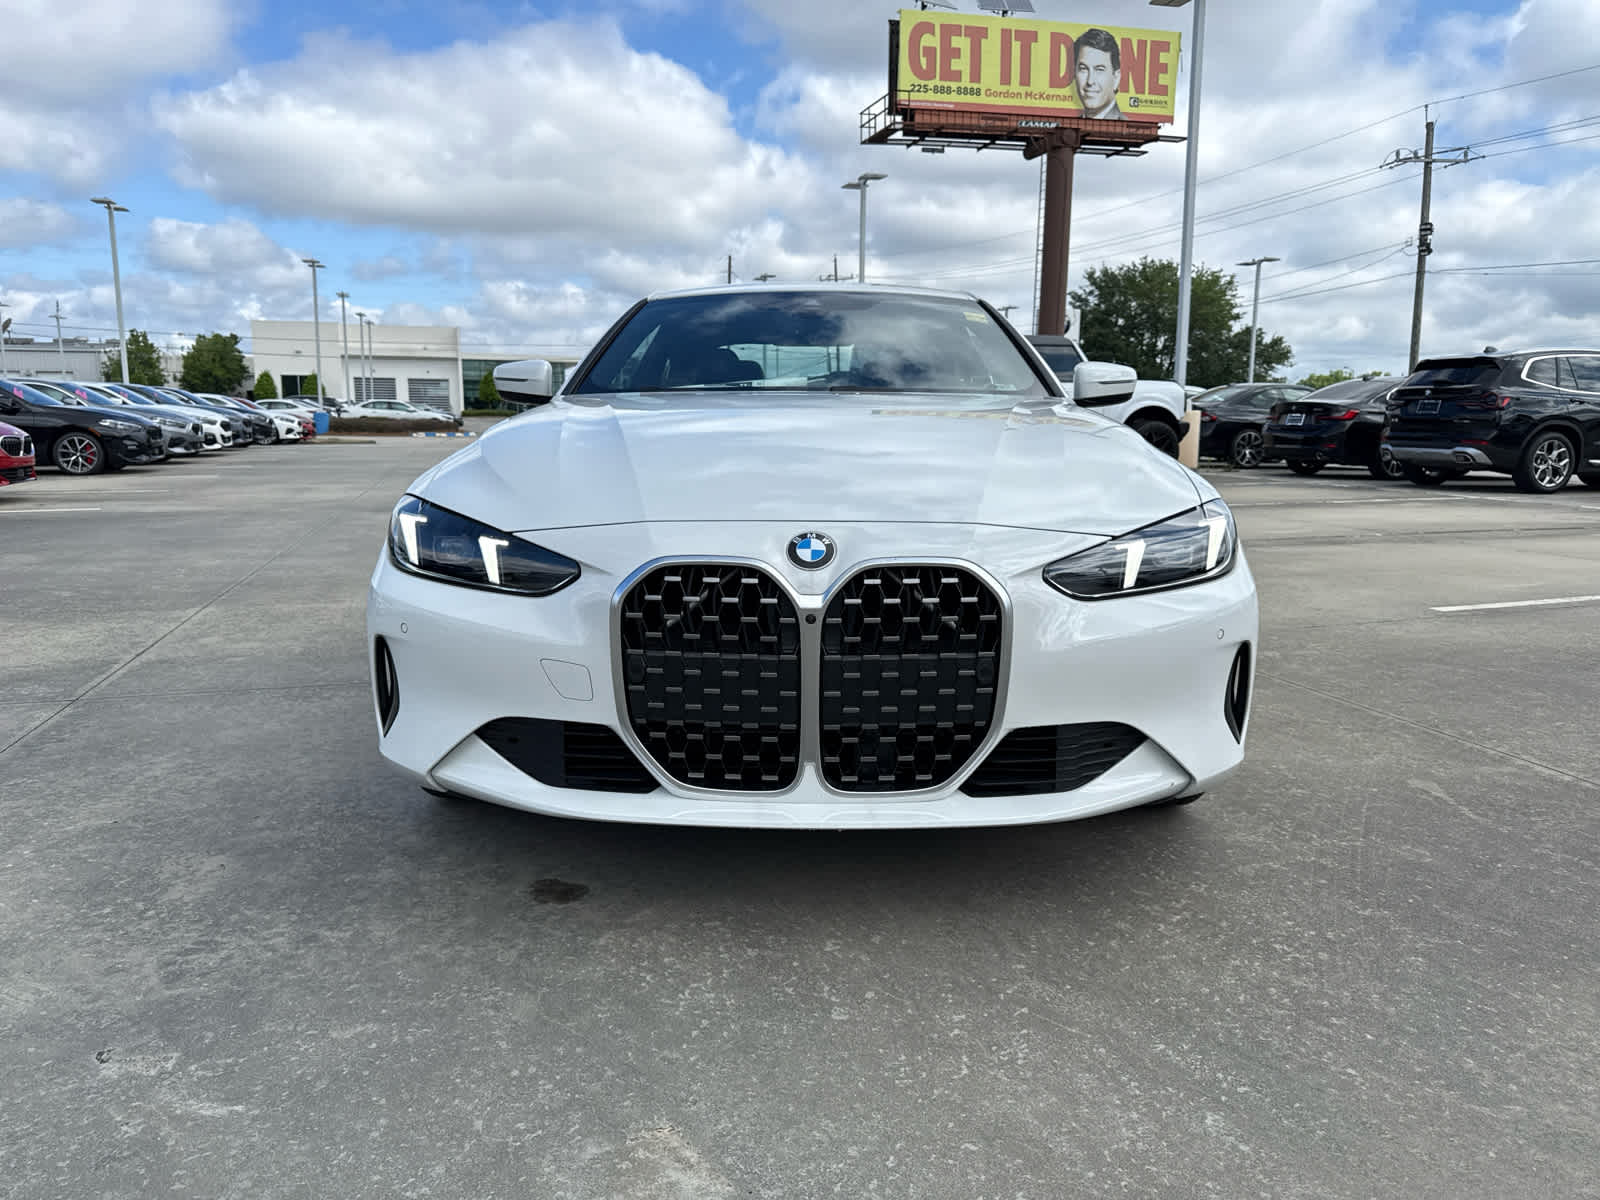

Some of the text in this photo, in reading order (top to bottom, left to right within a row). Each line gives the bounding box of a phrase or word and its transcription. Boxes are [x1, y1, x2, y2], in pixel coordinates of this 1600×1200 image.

[908, 21, 1170, 96] GET IT DNE
[910, 83, 981, 96] 225-888-8888
[984, 88, 1073, 102] Gordon McKernan
